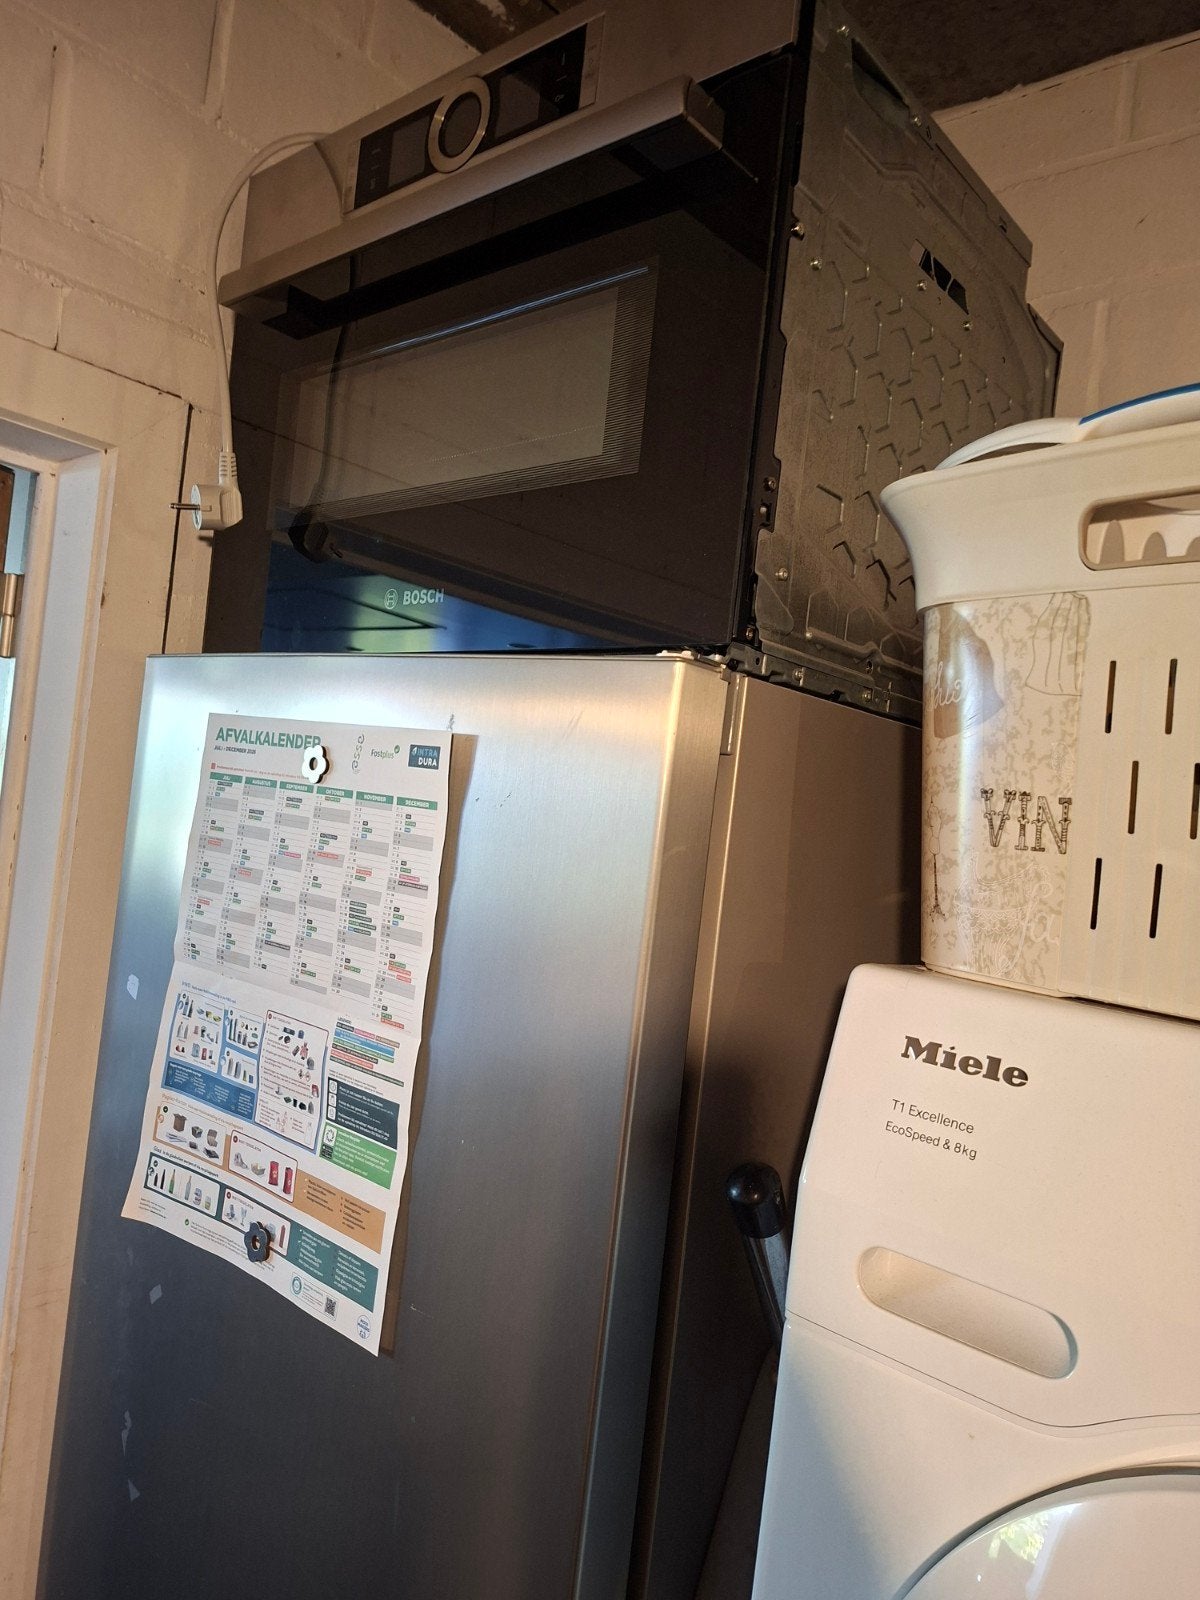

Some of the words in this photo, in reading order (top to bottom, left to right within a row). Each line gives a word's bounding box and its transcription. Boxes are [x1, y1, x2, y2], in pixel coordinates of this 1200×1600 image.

[402, 588, 445, 605] BOSCH
[215, 727, 322, 750] AFVALKALENDER
[226, 746, 247, 754] DECEMBER
[416, 748, 439, 758] INTRA
[418, 757, 438, 768] DURA
[286, 783, 308, 791] SEPTEMBER
[325, 789, 345, 797] OKTOBER
[363, 794, 387, 802] NOVEMBER
[405, 799, 430, 808] DECEMBER
[980, 788, 1073, 855] VIN
[900, 1035, 1029, 1088] Miele
[892, 1098, 906, 1114] T1
[908, 1104, 975, 1134] Excellence
[885, 1120, 941, 1147] EcoSpeed
[942, 1138, 951, 1151] &
[953, 1142, 978, 1162] 8kg
